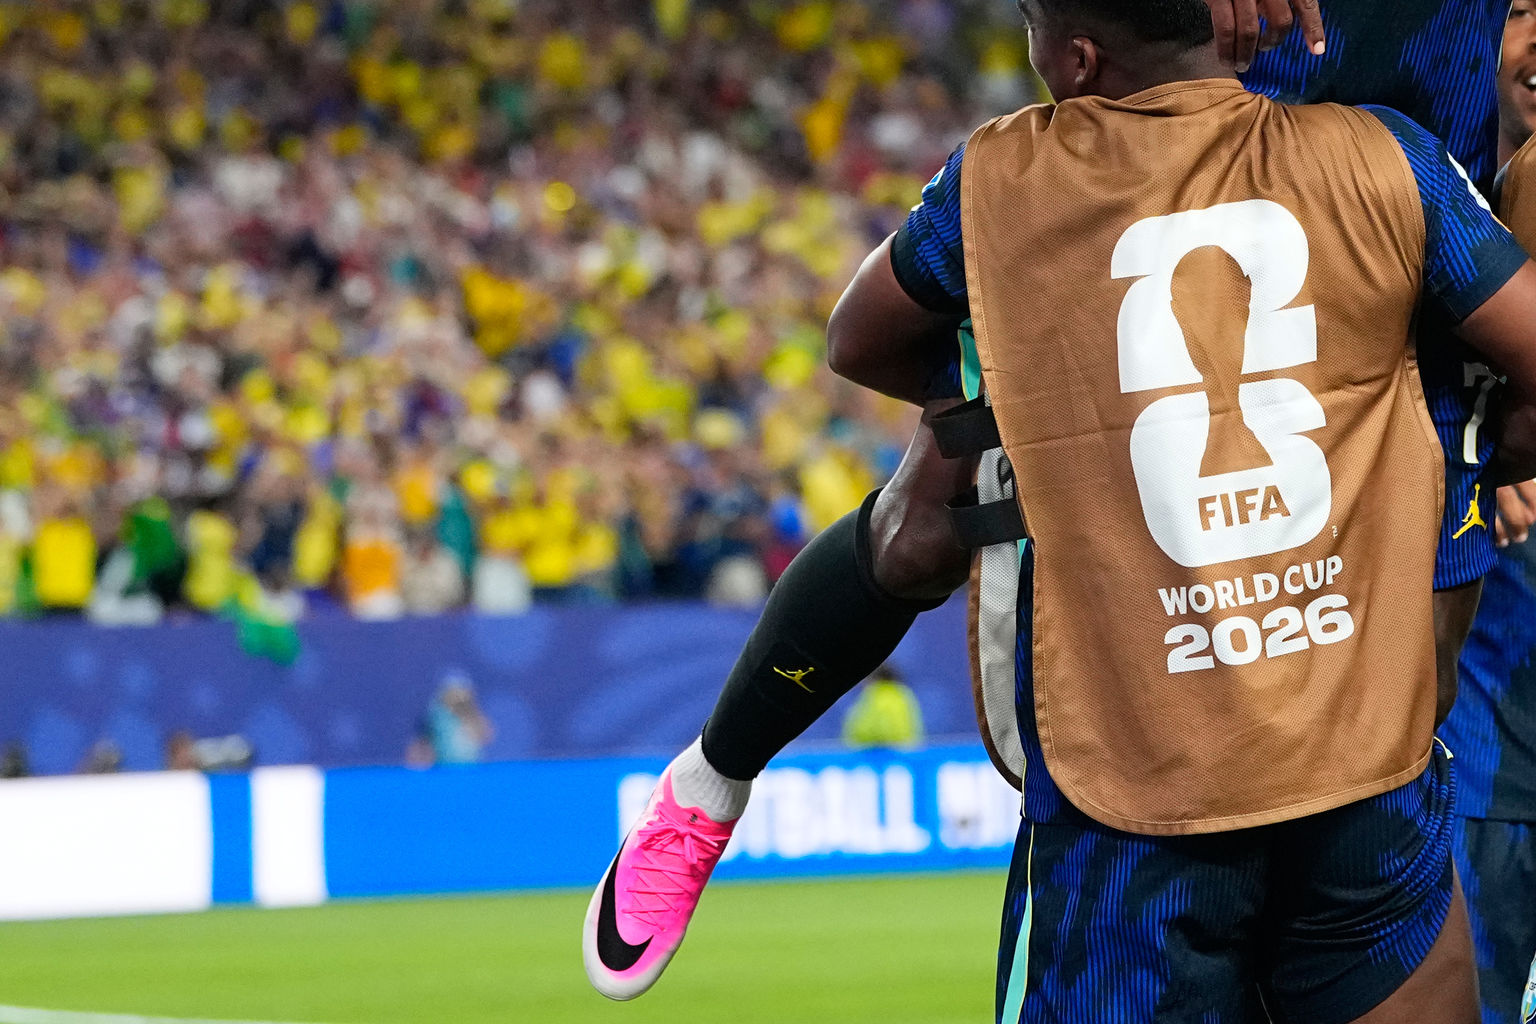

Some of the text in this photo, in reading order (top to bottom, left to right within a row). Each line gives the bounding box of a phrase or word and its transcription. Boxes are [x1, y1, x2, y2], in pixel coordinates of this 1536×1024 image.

[1197, 484, 1291, 532] FIFA
[1157, 555, 1343, 616] WORLD CUP
[1164, 594, 1355, 675] 2026
